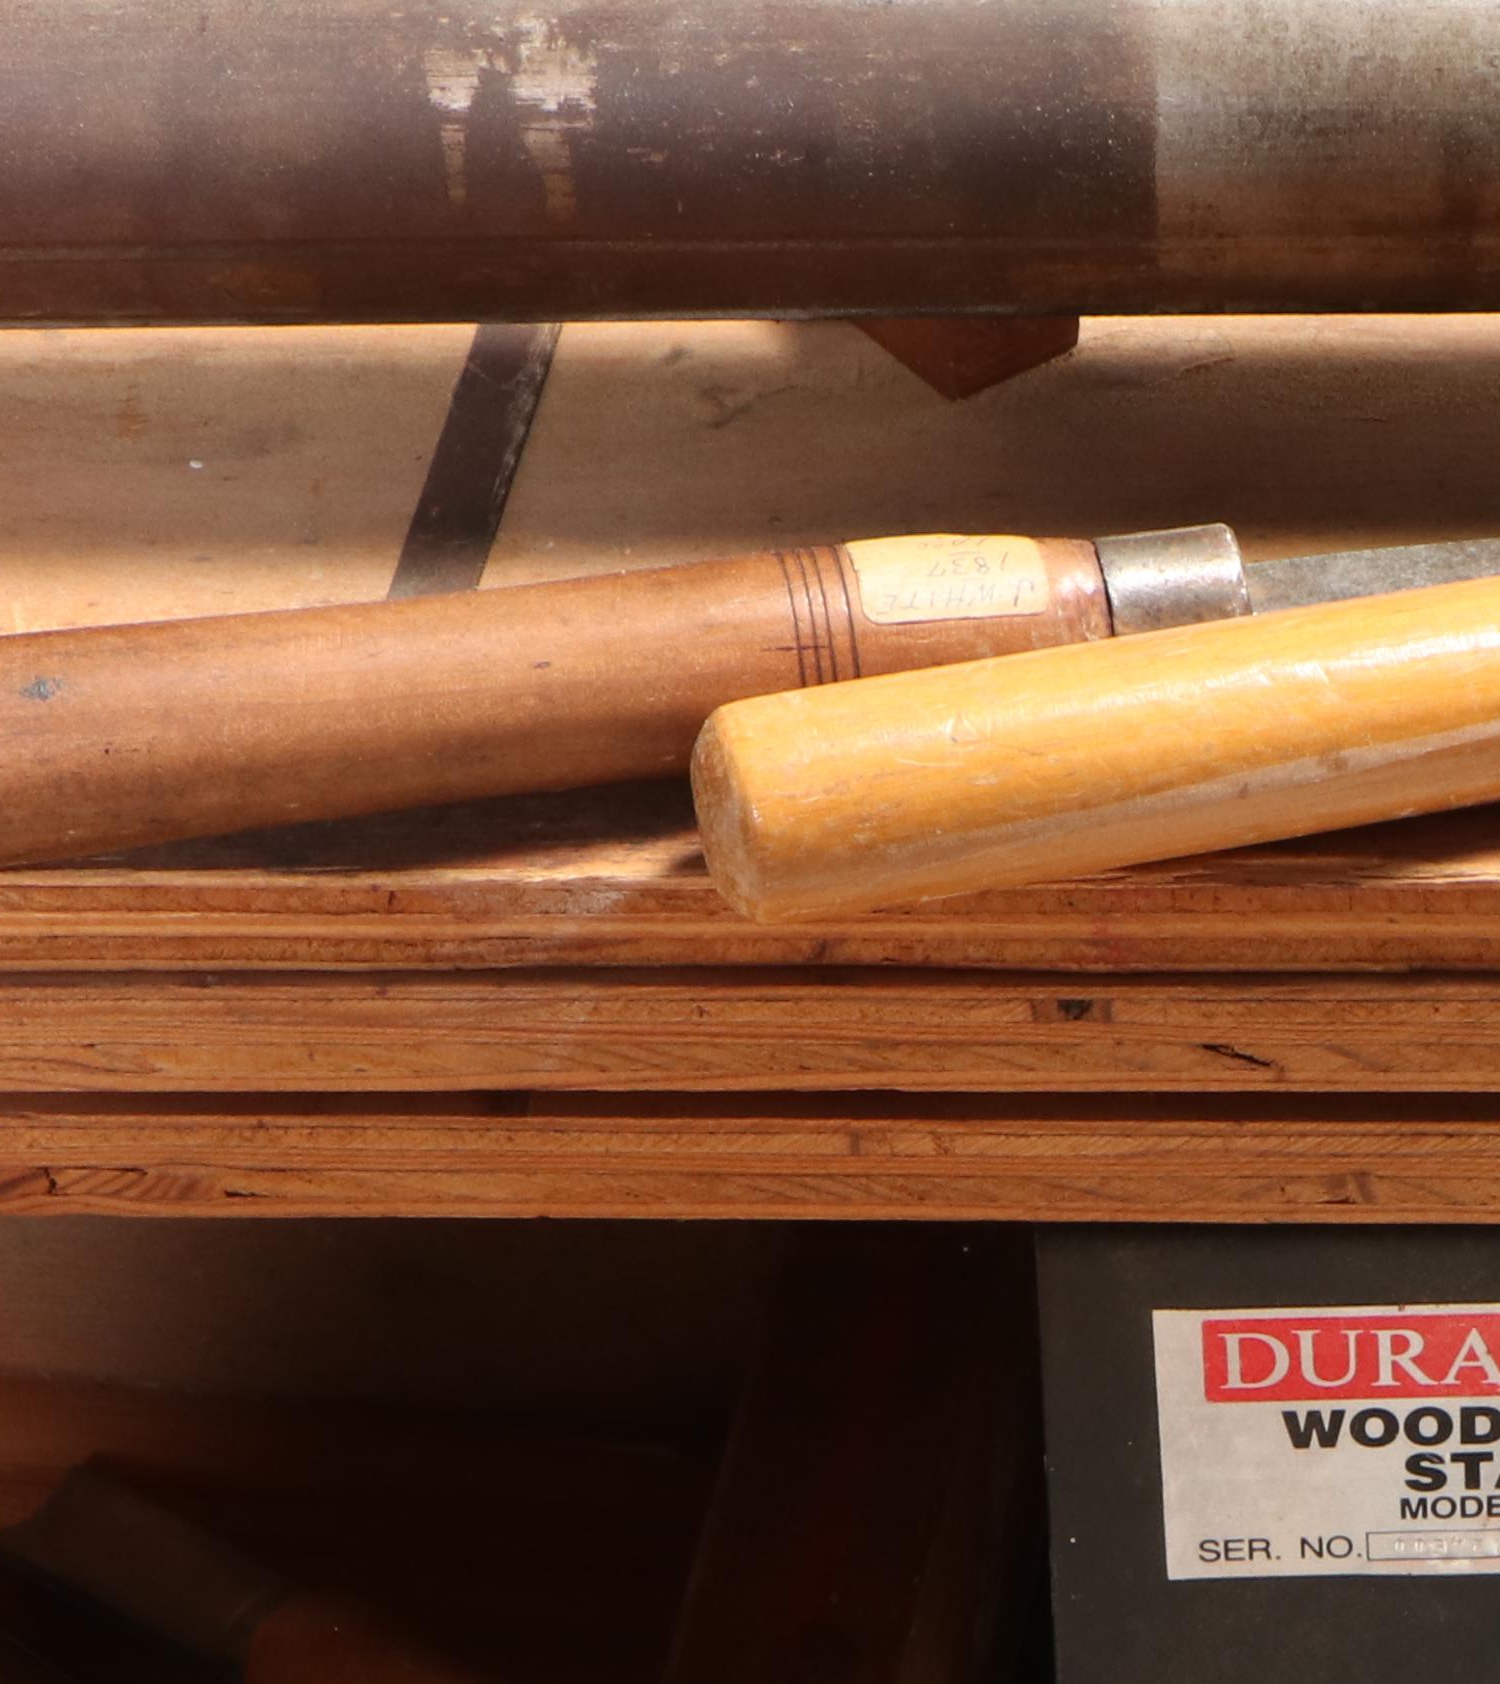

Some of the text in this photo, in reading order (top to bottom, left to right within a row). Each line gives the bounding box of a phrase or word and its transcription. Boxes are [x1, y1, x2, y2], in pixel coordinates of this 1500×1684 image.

[927, 551, 1009, 577] 1837
[1198, 1537, 1281, 1563] SER.
[1299, 1534, 1363, 1560] NO.
